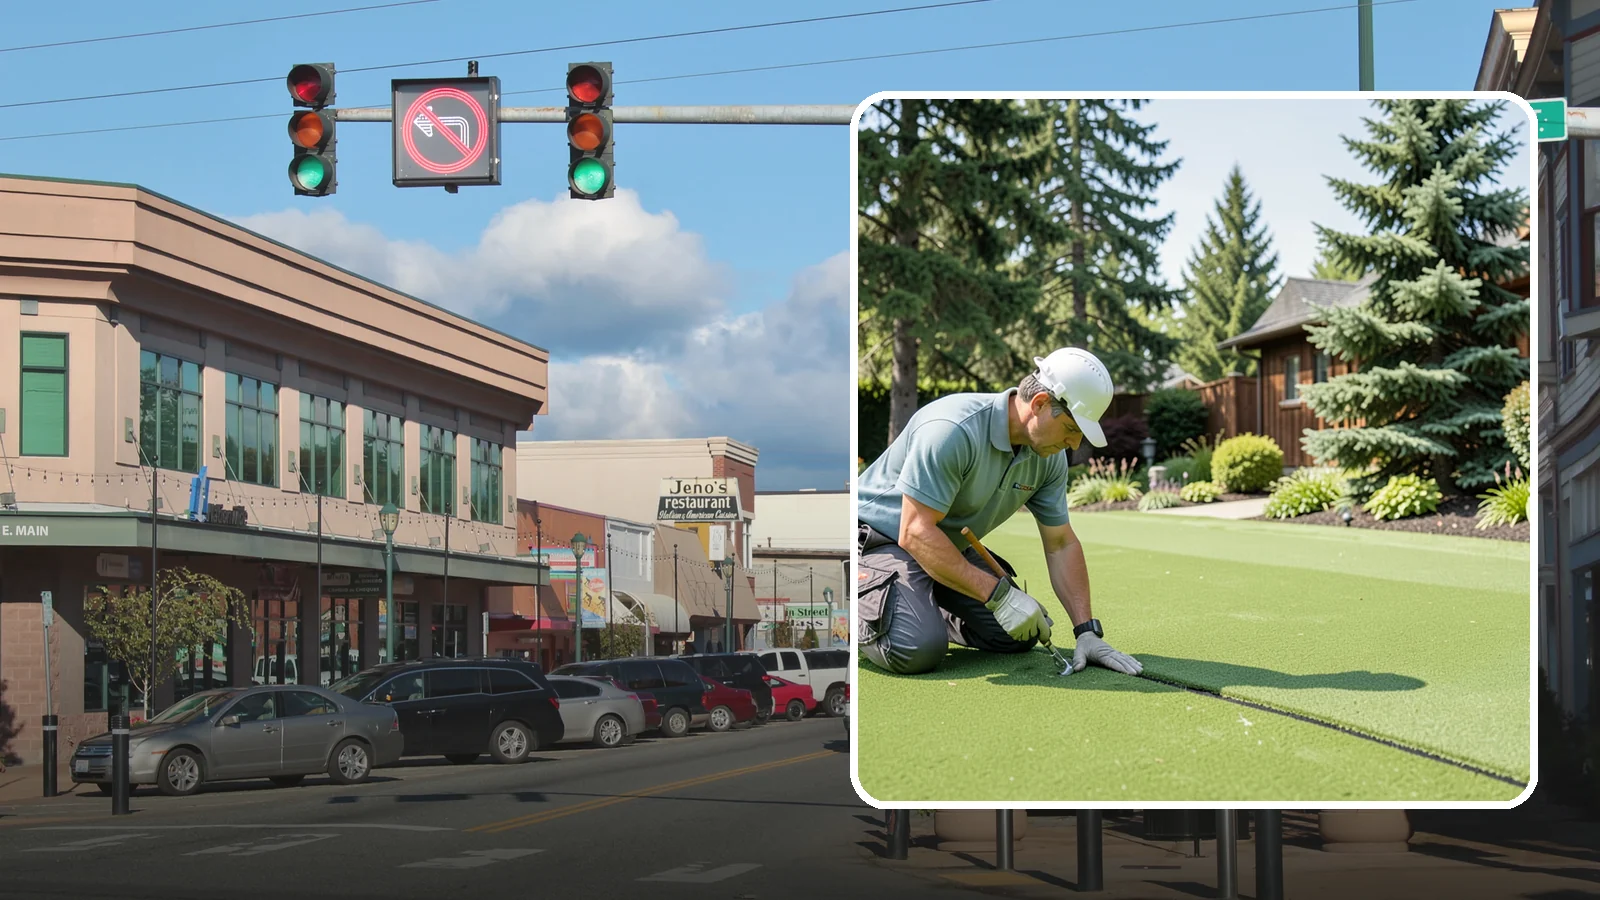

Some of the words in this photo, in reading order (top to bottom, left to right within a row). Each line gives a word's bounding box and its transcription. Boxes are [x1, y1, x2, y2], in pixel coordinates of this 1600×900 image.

[669, 480, 727, 494] Jeno's
[665, 496, 731, 509] restaurant
[659, 510, 682, 519] Italian
[686, 509, 714, 519] American
[715, 509, 737, 519] Cuisine
[2, 525, 13, 536] E.
[15, 525, 49, 536] MAIN
[797, 607, 828, 617] Street
